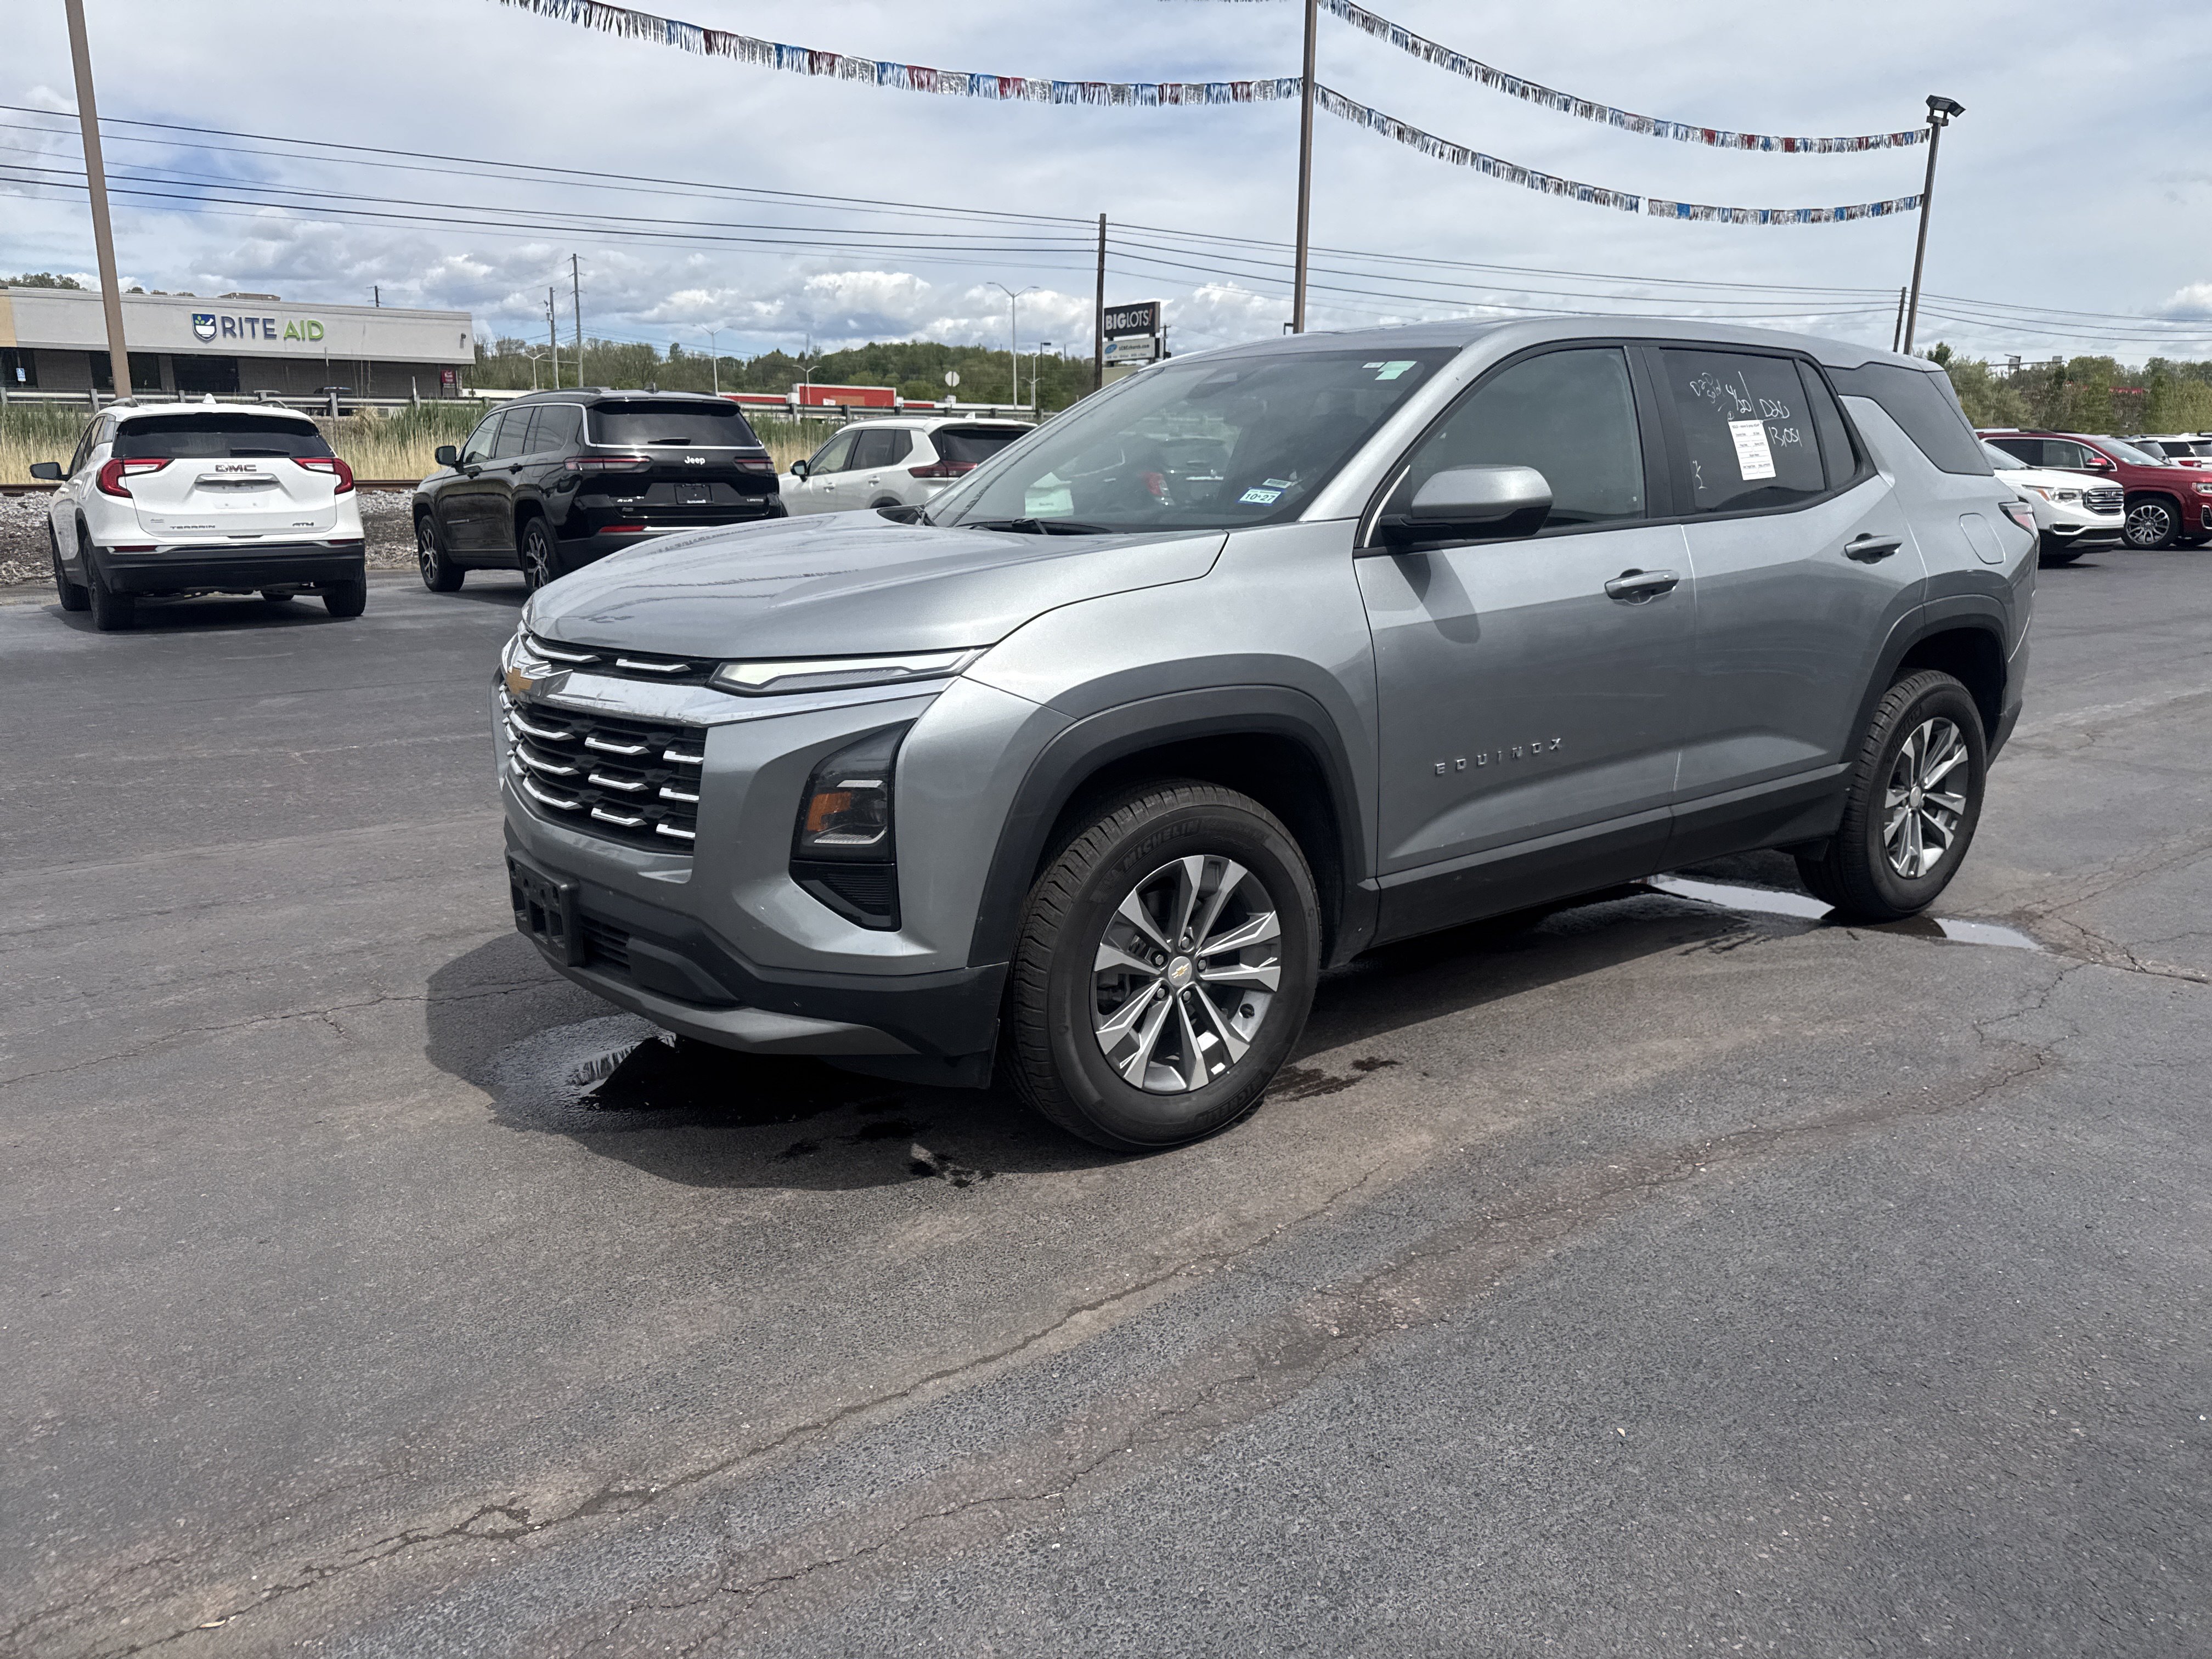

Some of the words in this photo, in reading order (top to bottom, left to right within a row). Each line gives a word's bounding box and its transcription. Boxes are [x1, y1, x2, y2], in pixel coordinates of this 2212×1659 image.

[221, 316, 277, 339] RITE
[284, 320, 324, 342] AID
[685, 456, 706, 465] Jeep
[1435, 738, 1562, 775] EQUINOX
[1124, 821, 1200, 869] MICHELIN
